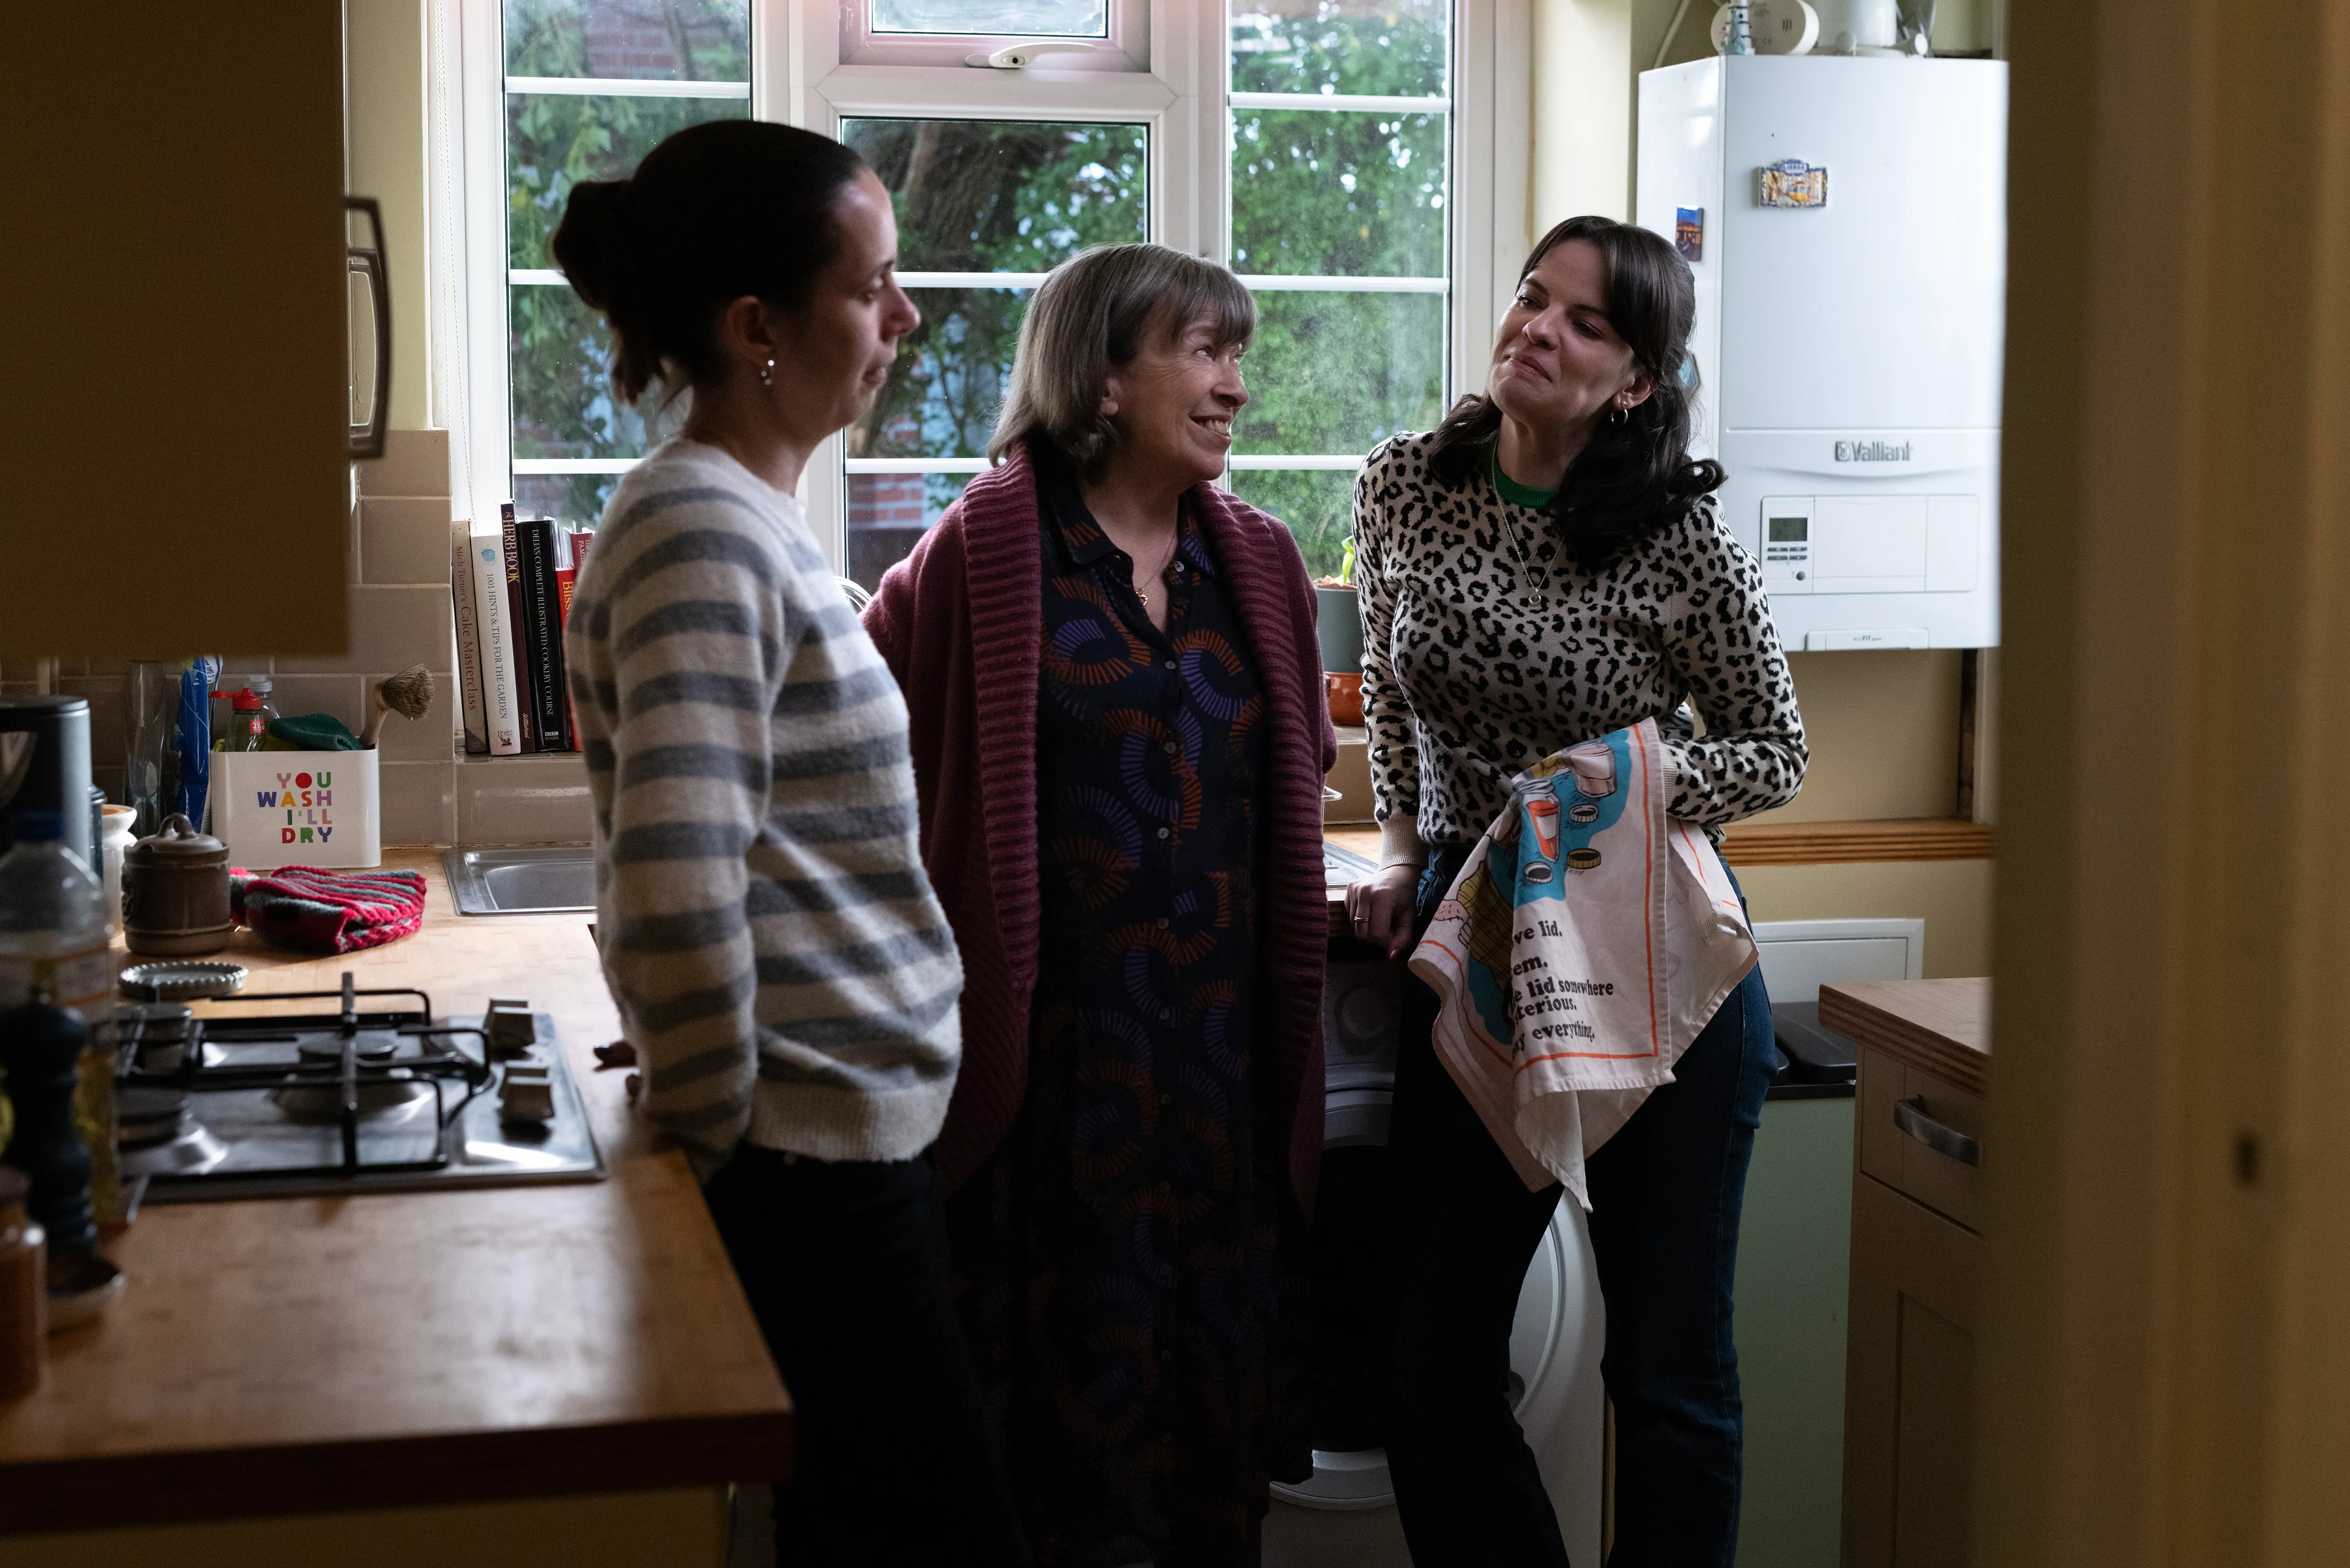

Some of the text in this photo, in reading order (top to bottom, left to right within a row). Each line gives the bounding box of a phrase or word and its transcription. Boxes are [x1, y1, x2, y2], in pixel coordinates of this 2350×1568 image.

[1851, 441, 1912, 461] Vaillant
[502, 519, 516, 550] HERB
[506, 551, 520, 584] BOOK
[534, 556, 544, 596] COMPLETE
[487, 573, 495, 588] 1001
[489, 591, 498, 617] HINTS
[456, 547, 478, 710] Mich Turner's Cake Masterclass
[537, 597, 548, 645] ILLUSTRATED
[492, 627, 500, 645] TIPS
[494, 646, 502, 663] FOR
[542, 647, 551, 684] COOKERY
[495, 665, 504, 682] THE
[497, 684, 508, 719] GARDEN
[545, 686, 554, 716] COURSE
[276, 772, 331, 789] YOU
[257, 790, 332, 808] WASH
[287, 809, 332, 826] I'LL
[281, 827, 332, 844] DRY
[1537, 920, 1562, 937] lid.
[1513, 956, 1548, 975] em.
[1526, 976, 1556, 998] lid
[1558, 979, 1614, 996] somewhere
[1515, 995, 1577, 1025] terious.
[1532, 1020, 1595, 1043] everything.
